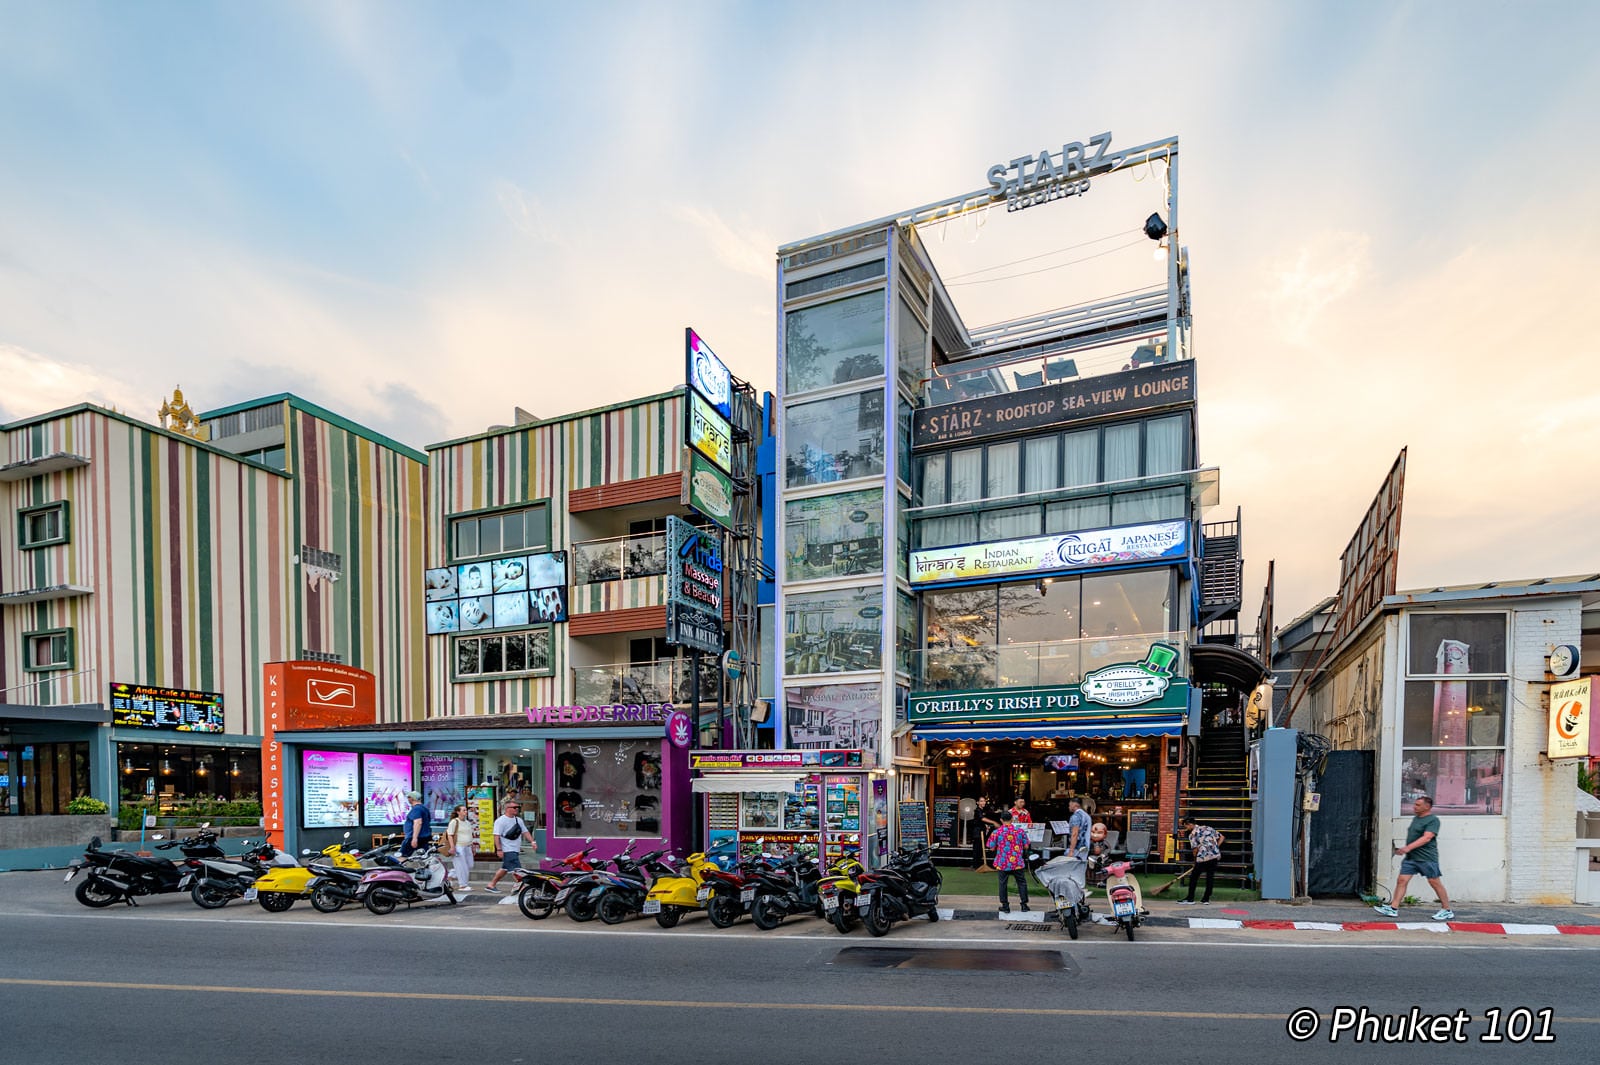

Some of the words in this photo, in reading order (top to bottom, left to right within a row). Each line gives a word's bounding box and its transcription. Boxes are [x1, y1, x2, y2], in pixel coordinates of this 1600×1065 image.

[986, 131, 1112, 196] STARZ
[1007, 178, 1091, 213] Rooftop
[930, 408, 983, 434] STARZ
[996, 400, 1055, 422] ROOFTOP
[1062, 387, 1127, 411] SEA-VIEW
[1134, 376, 1189, 398] LOUNGE
[1121, 531, 1179, 546] JAPANESE
[1126, 541, 1173, 550] RESTAURANT
[678, 534, 722, 573] Anda
[915, 552, 966, 573] kiran's
[685, 562, 719, 589] Massage
[683, 581, 691, 596] &
[692, 584, 720, 609] Beauty
[680, 622, 694, 638] INK
[135, 687, 158, 695] Anda
[1106, 680, 1143, 689] O'REILLY'S
[525, 703, 676, 723] WEEDBERRIES
[915, 698, 994, 713] O'REILLY'S
[998, 696, 1041, 710] IRISH
[1046, 694, 1080, 708] PUB
[269, 741, 278, 771] Sea
[270, 777, 278, 829] Sands
